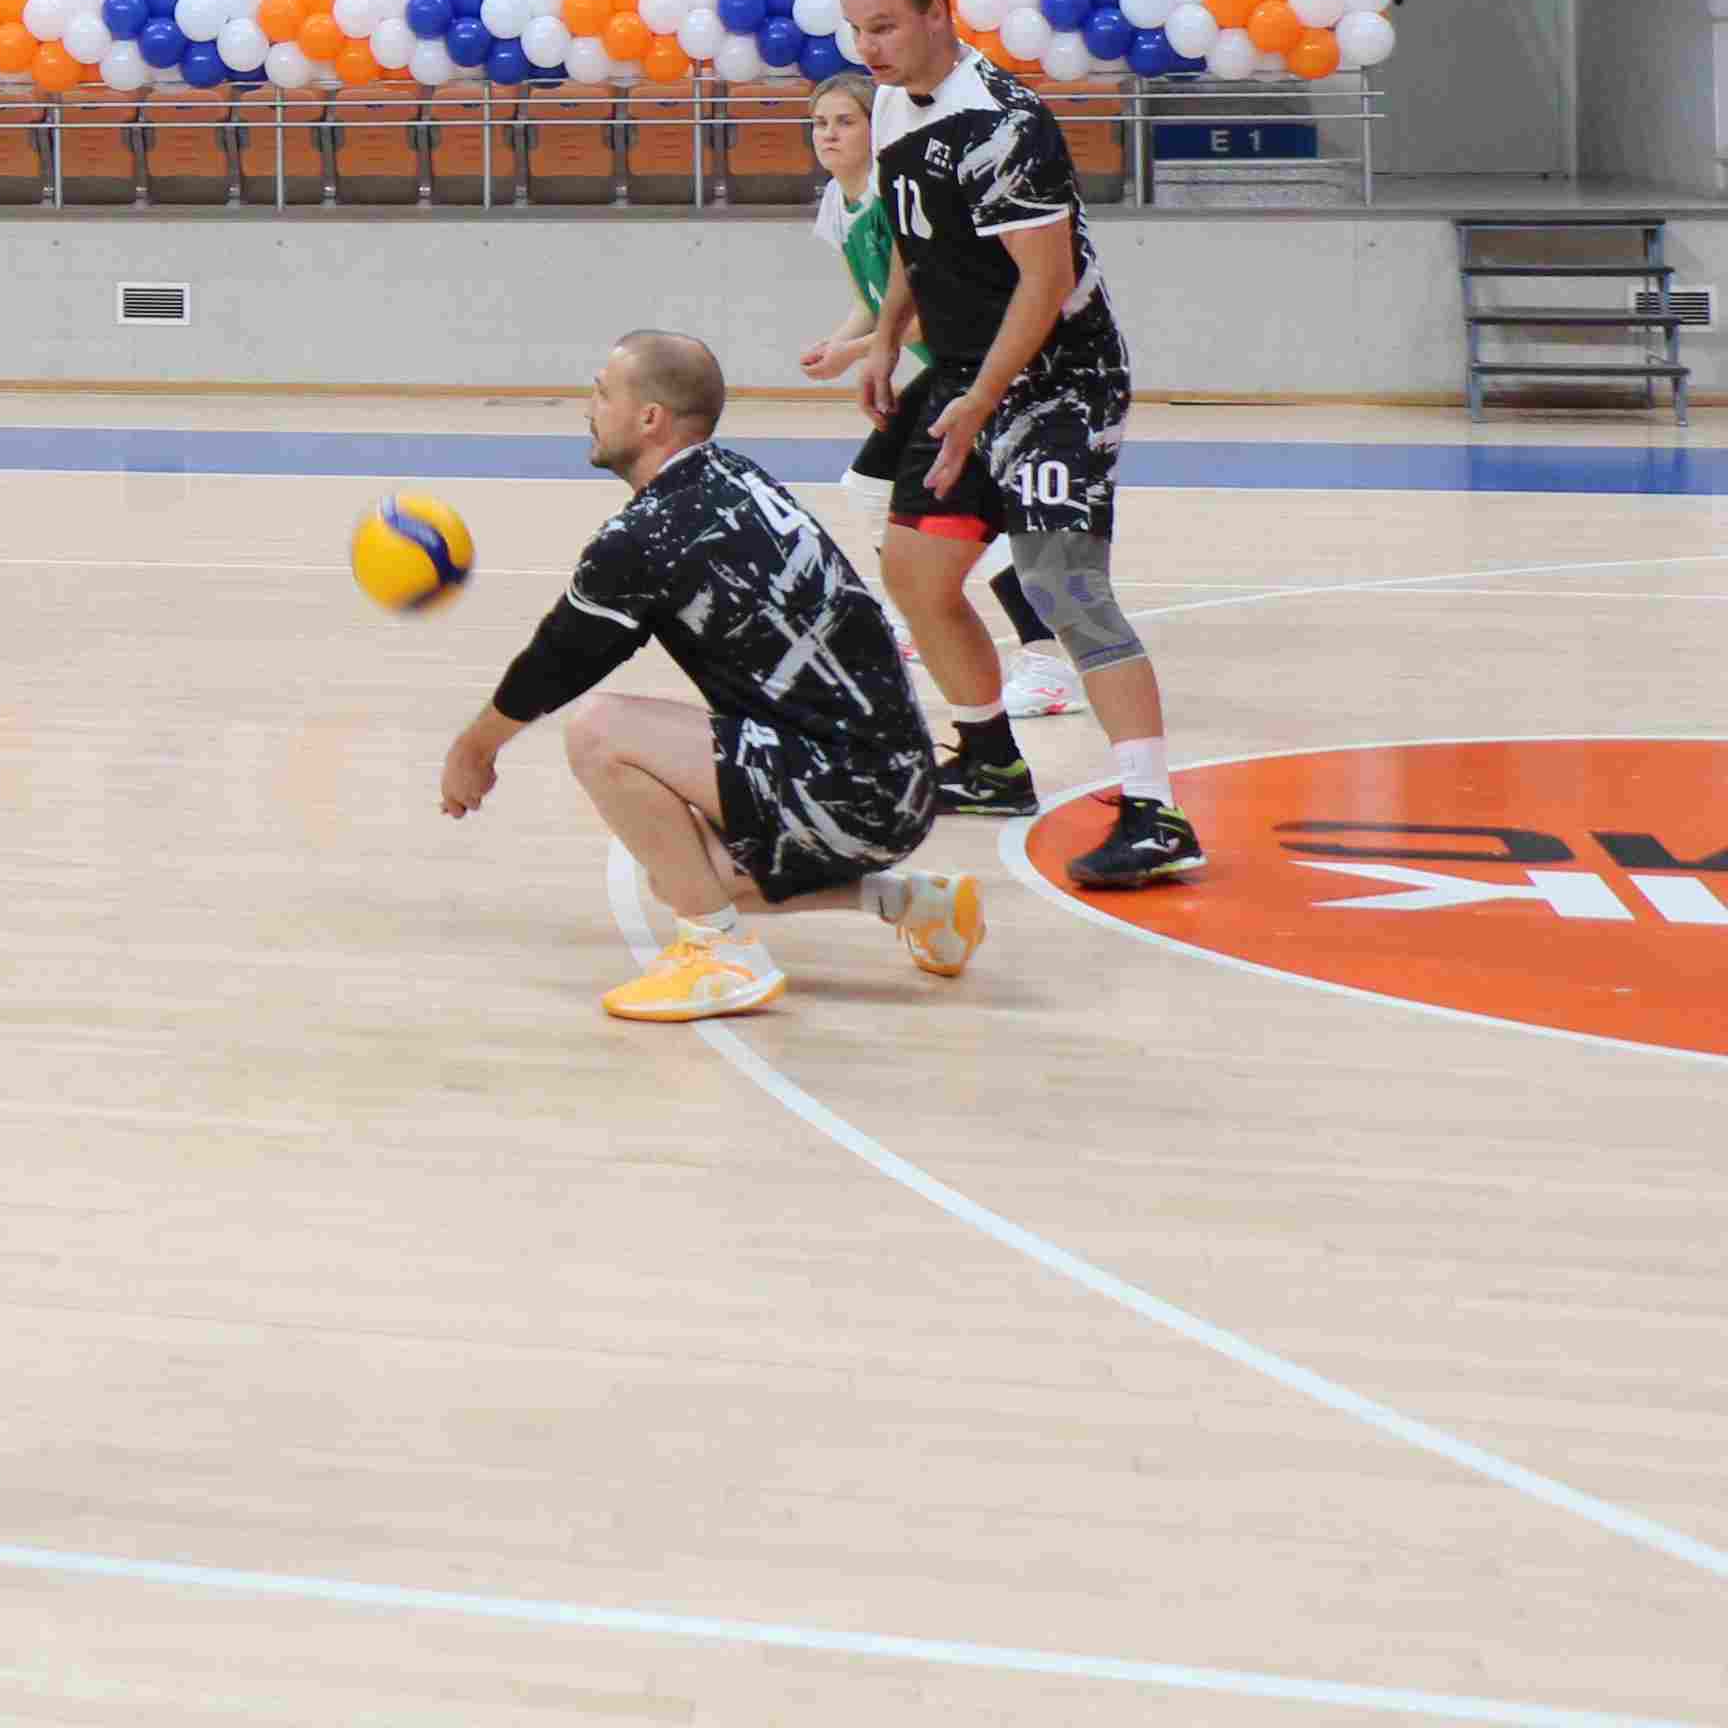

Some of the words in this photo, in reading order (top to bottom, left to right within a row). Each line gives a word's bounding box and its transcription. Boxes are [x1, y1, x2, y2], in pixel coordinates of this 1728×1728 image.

[1210, 129, 1229, 152] E
[1248, 129, 1262, 151] 1
[740, 472, 821, 537] 4
[1017, 460, 1070, 506] 10
